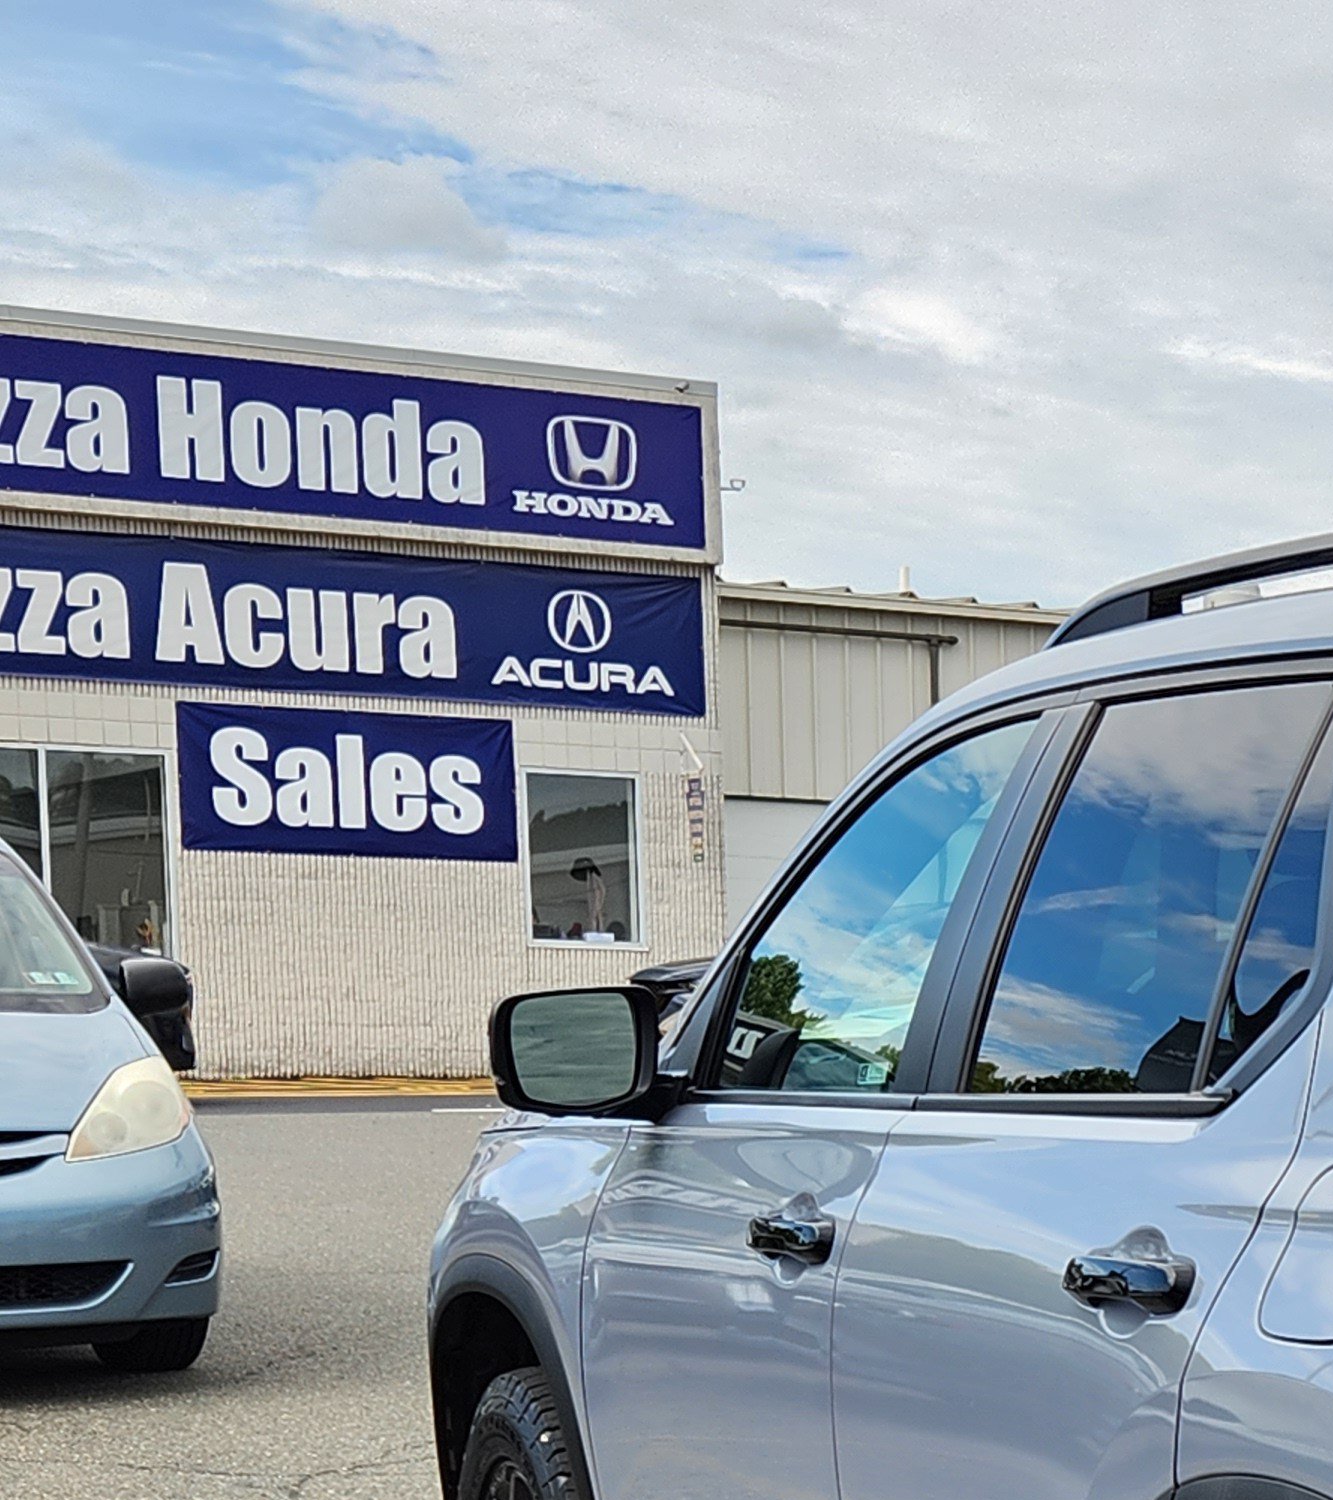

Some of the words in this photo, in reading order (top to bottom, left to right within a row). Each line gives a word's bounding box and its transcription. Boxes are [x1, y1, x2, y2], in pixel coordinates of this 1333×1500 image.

[0, 377, 130, 474] za
[156, 374, 487, 505] Honda
[512, 489, 675, 526] HONDA
[0, 567, 131, 660] za
[155, 561, 458, 679] Acura
[492, 655, 675, 696] ACURA
[208, 726, 485, 834] Sales
